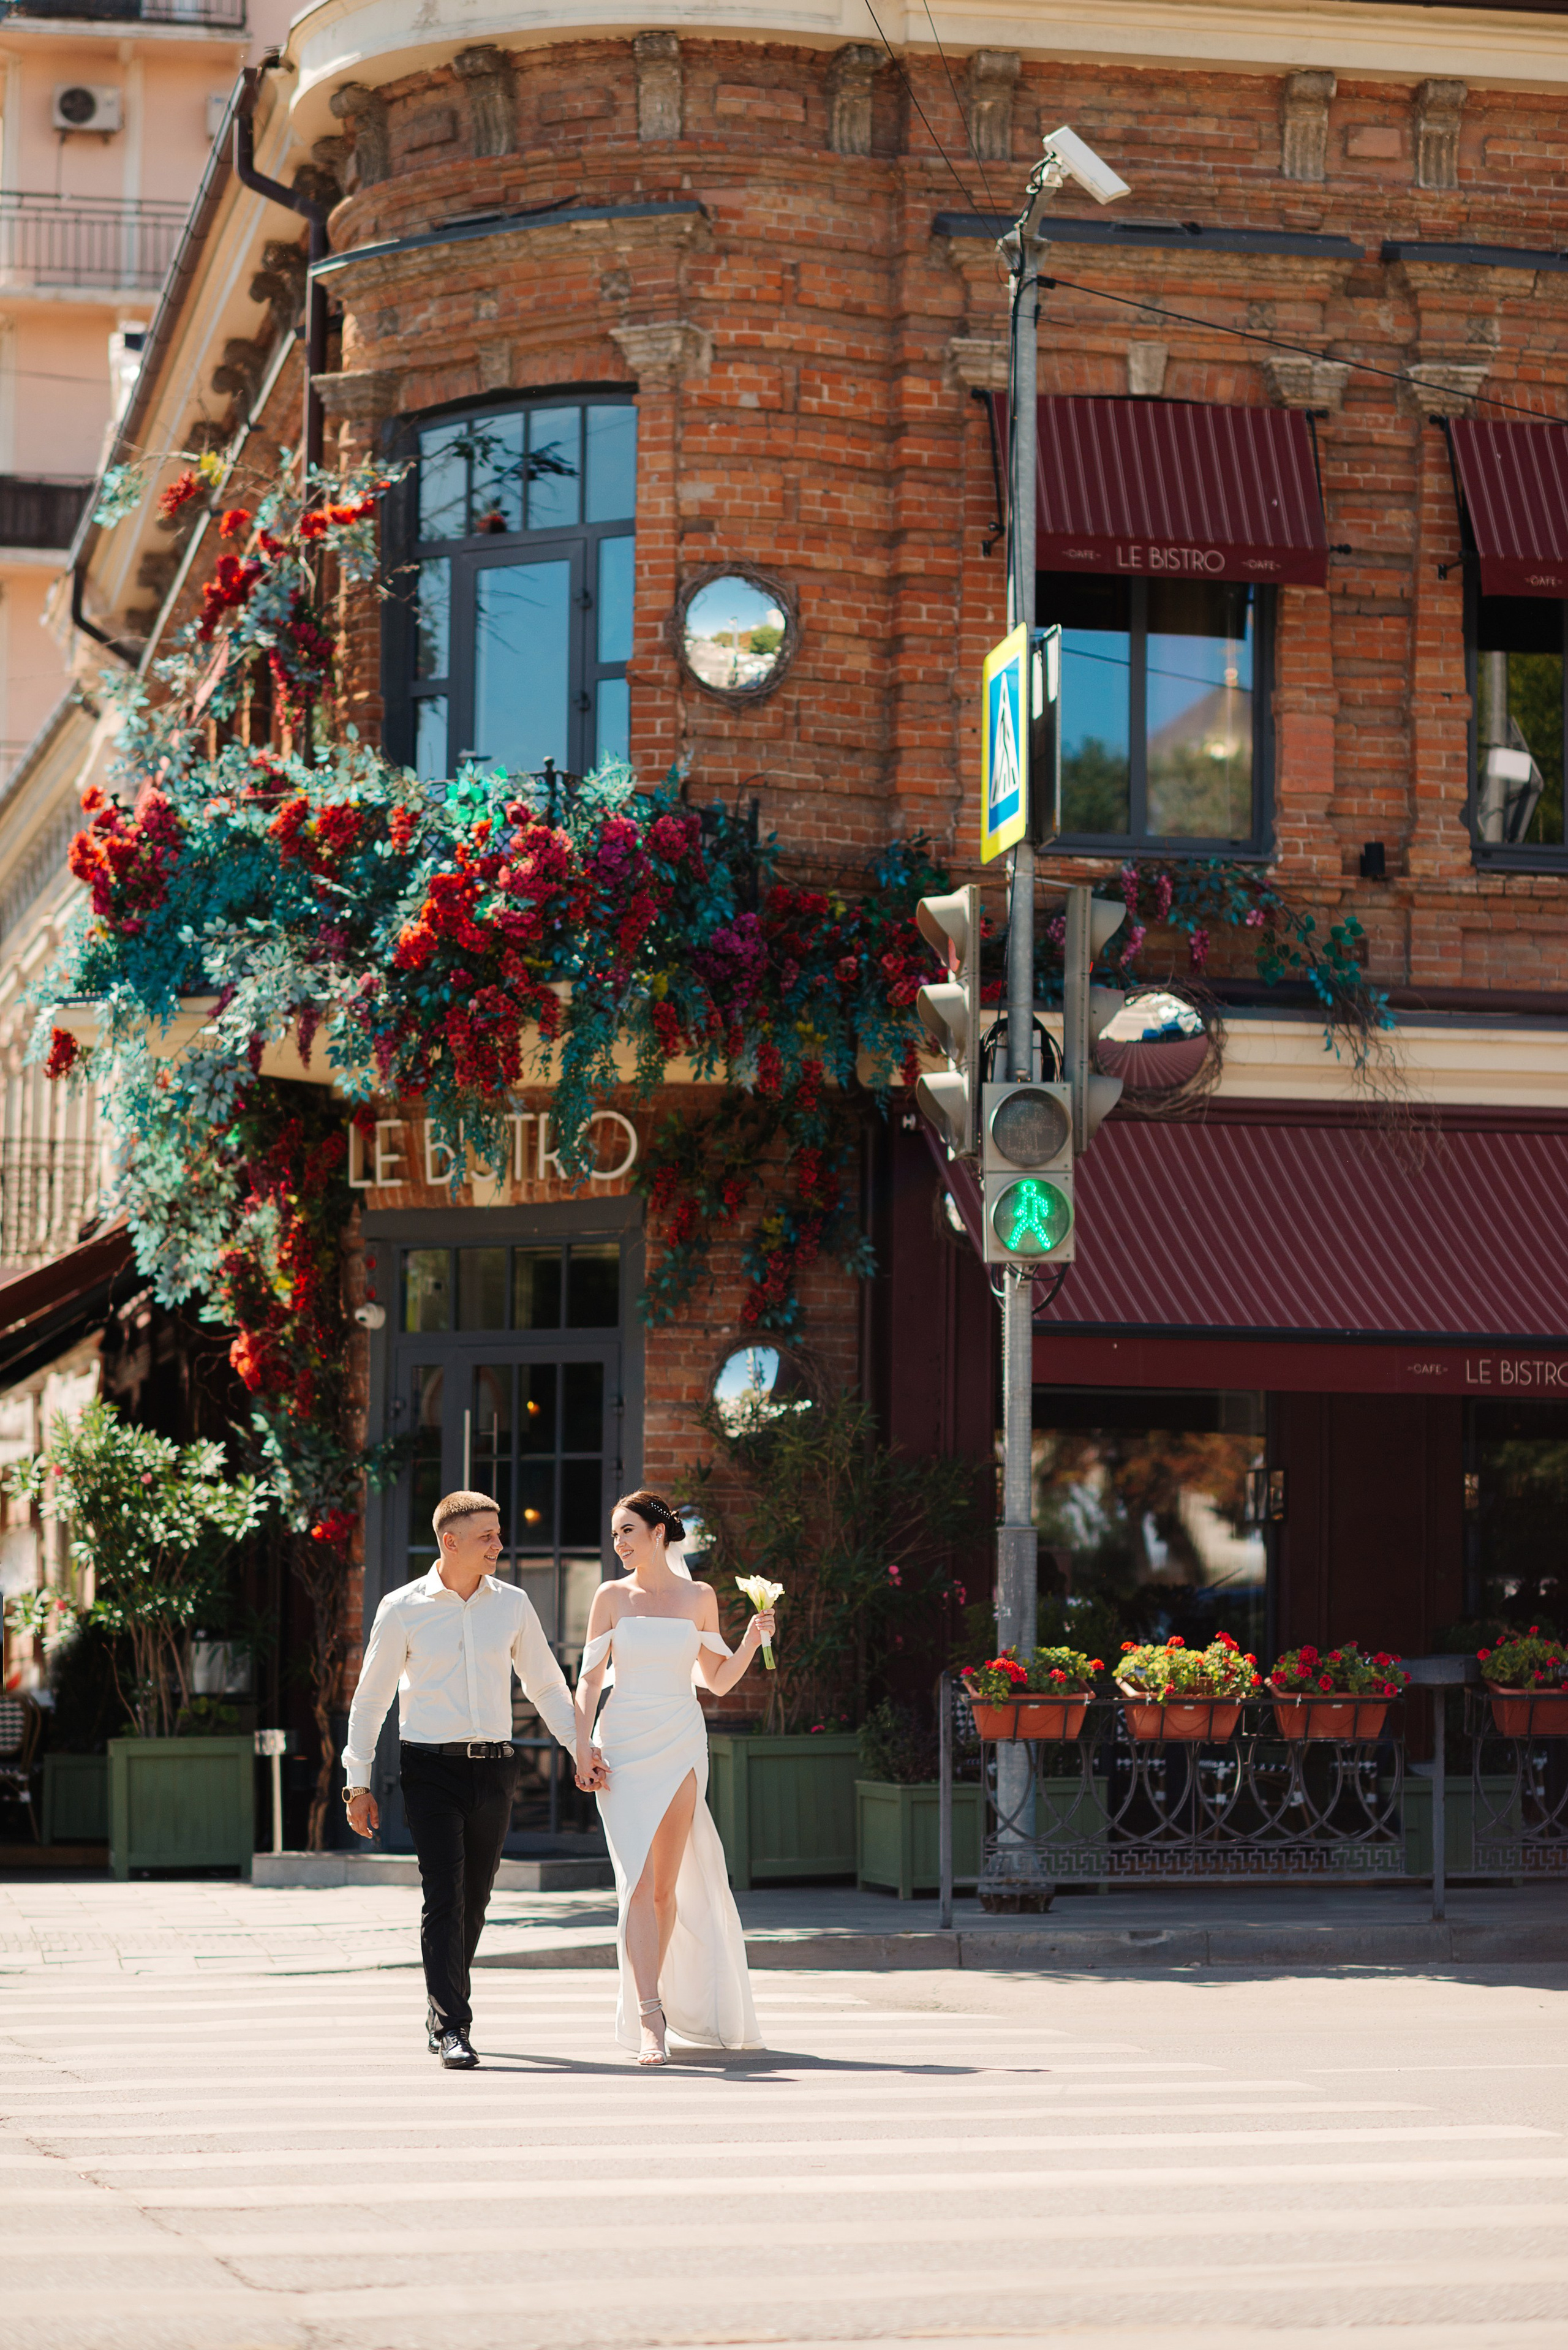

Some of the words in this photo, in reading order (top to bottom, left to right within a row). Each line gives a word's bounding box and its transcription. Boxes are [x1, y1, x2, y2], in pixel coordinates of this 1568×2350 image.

[1116, 545, 1143, 568] LE
[1148, 546, 1226, 573] BISTRO
[348, 1119, 404, 1189] LE
[1466, 1358, 1492, 1384] LE
